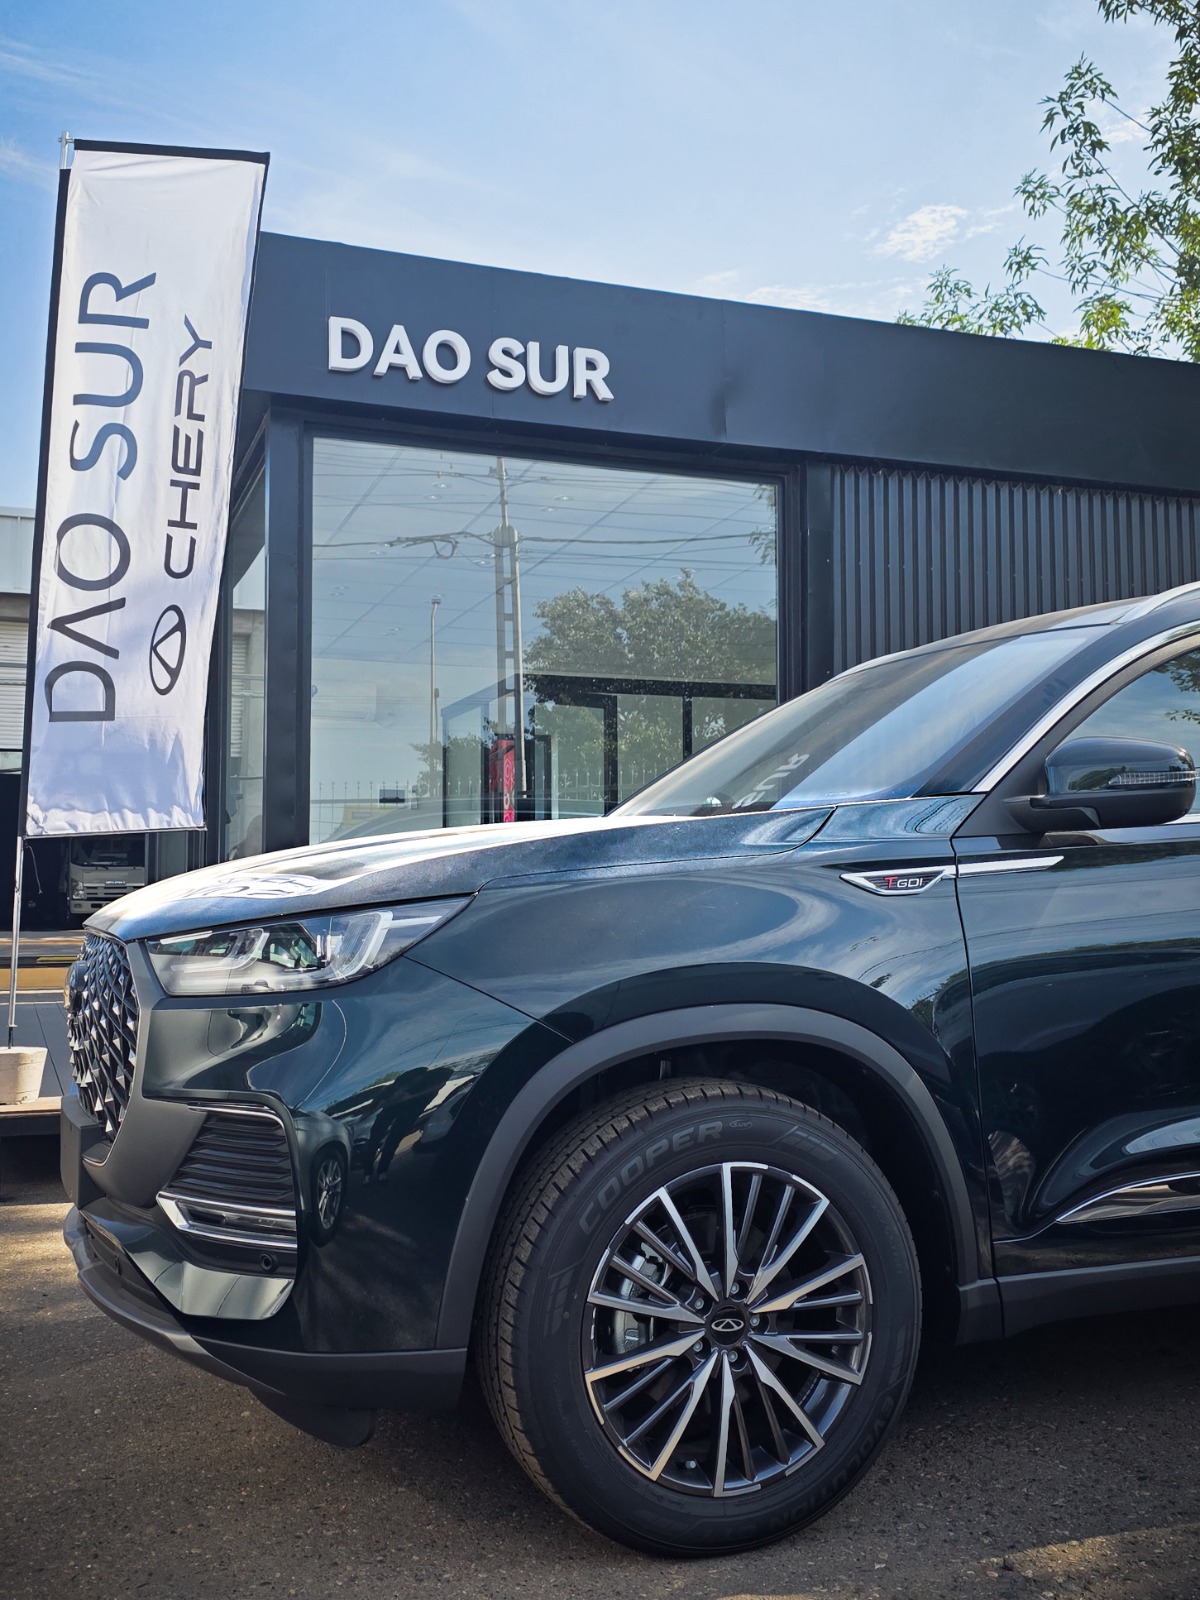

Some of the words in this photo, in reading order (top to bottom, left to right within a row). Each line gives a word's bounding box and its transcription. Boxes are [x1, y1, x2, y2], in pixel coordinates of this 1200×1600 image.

[69, 272, 156, 481] SUR
[164, 314, 212, 579] CHERY
[328, 316, 471, 384] DAO
[486, 337, 614, 401] SUR
[44, 513, 131, 722] DAO
[578, 1120, 723, 1236] COOPER
